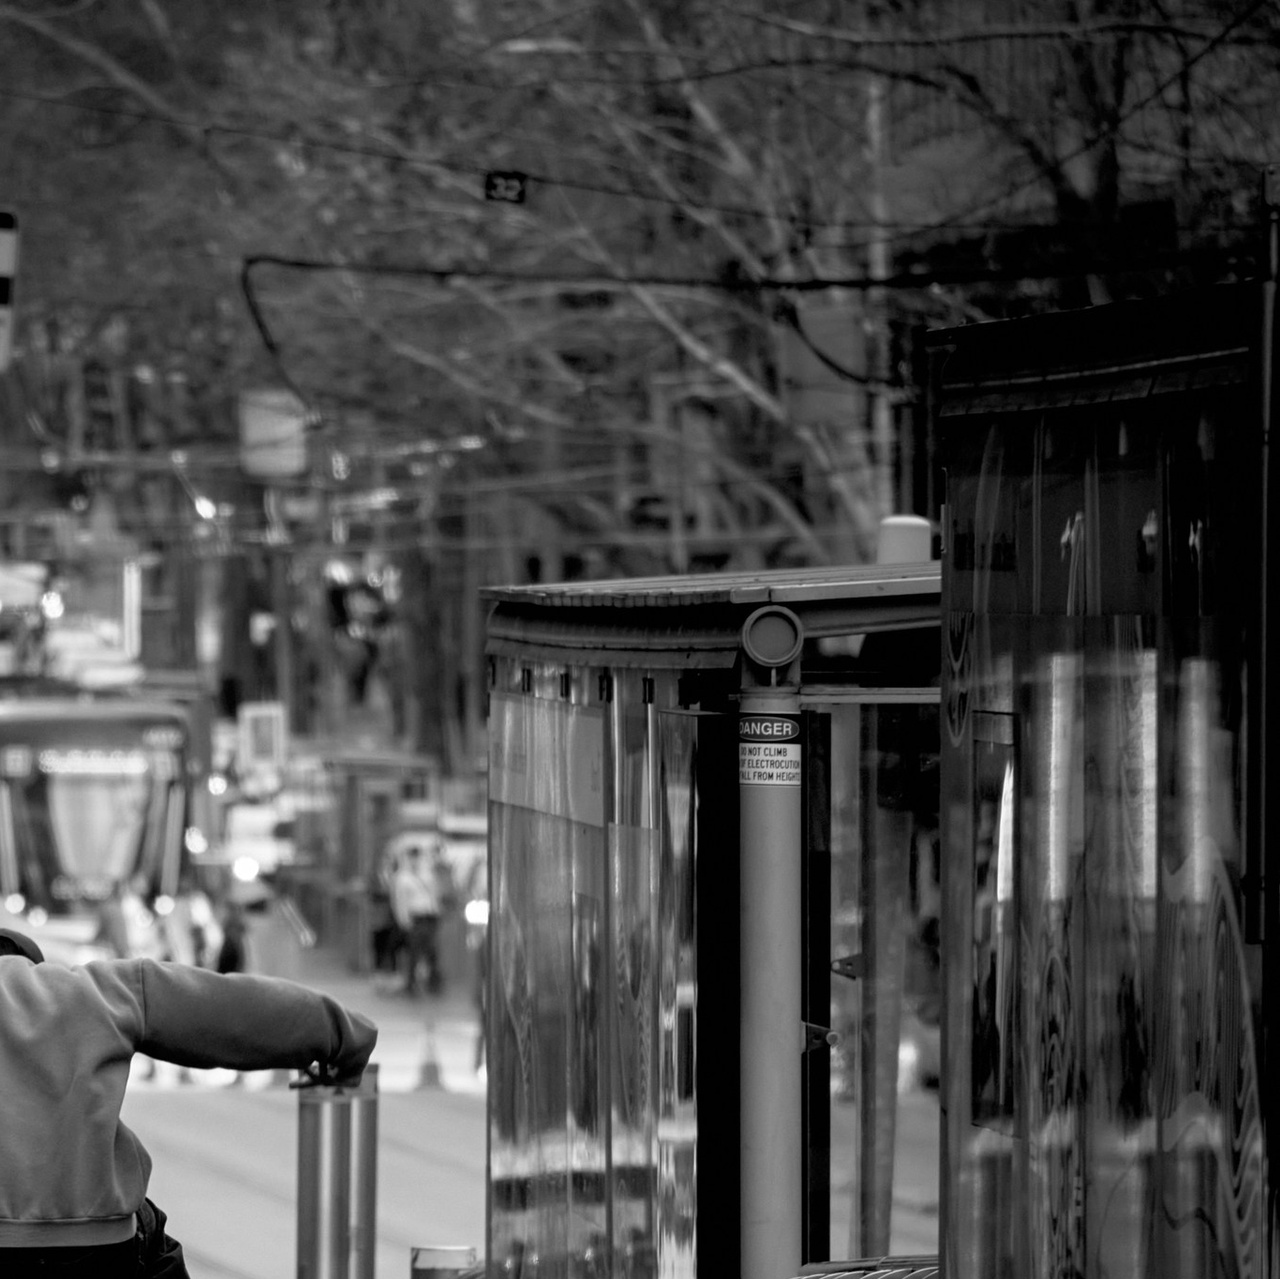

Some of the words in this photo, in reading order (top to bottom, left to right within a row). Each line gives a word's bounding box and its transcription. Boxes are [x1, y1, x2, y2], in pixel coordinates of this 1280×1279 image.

[739, 721, 792, 736] DANGER
[747, 746, 762, 757] NOT
[763, 747, 788, 758] CLIMB
[753, 771, 774, 781] FROM
